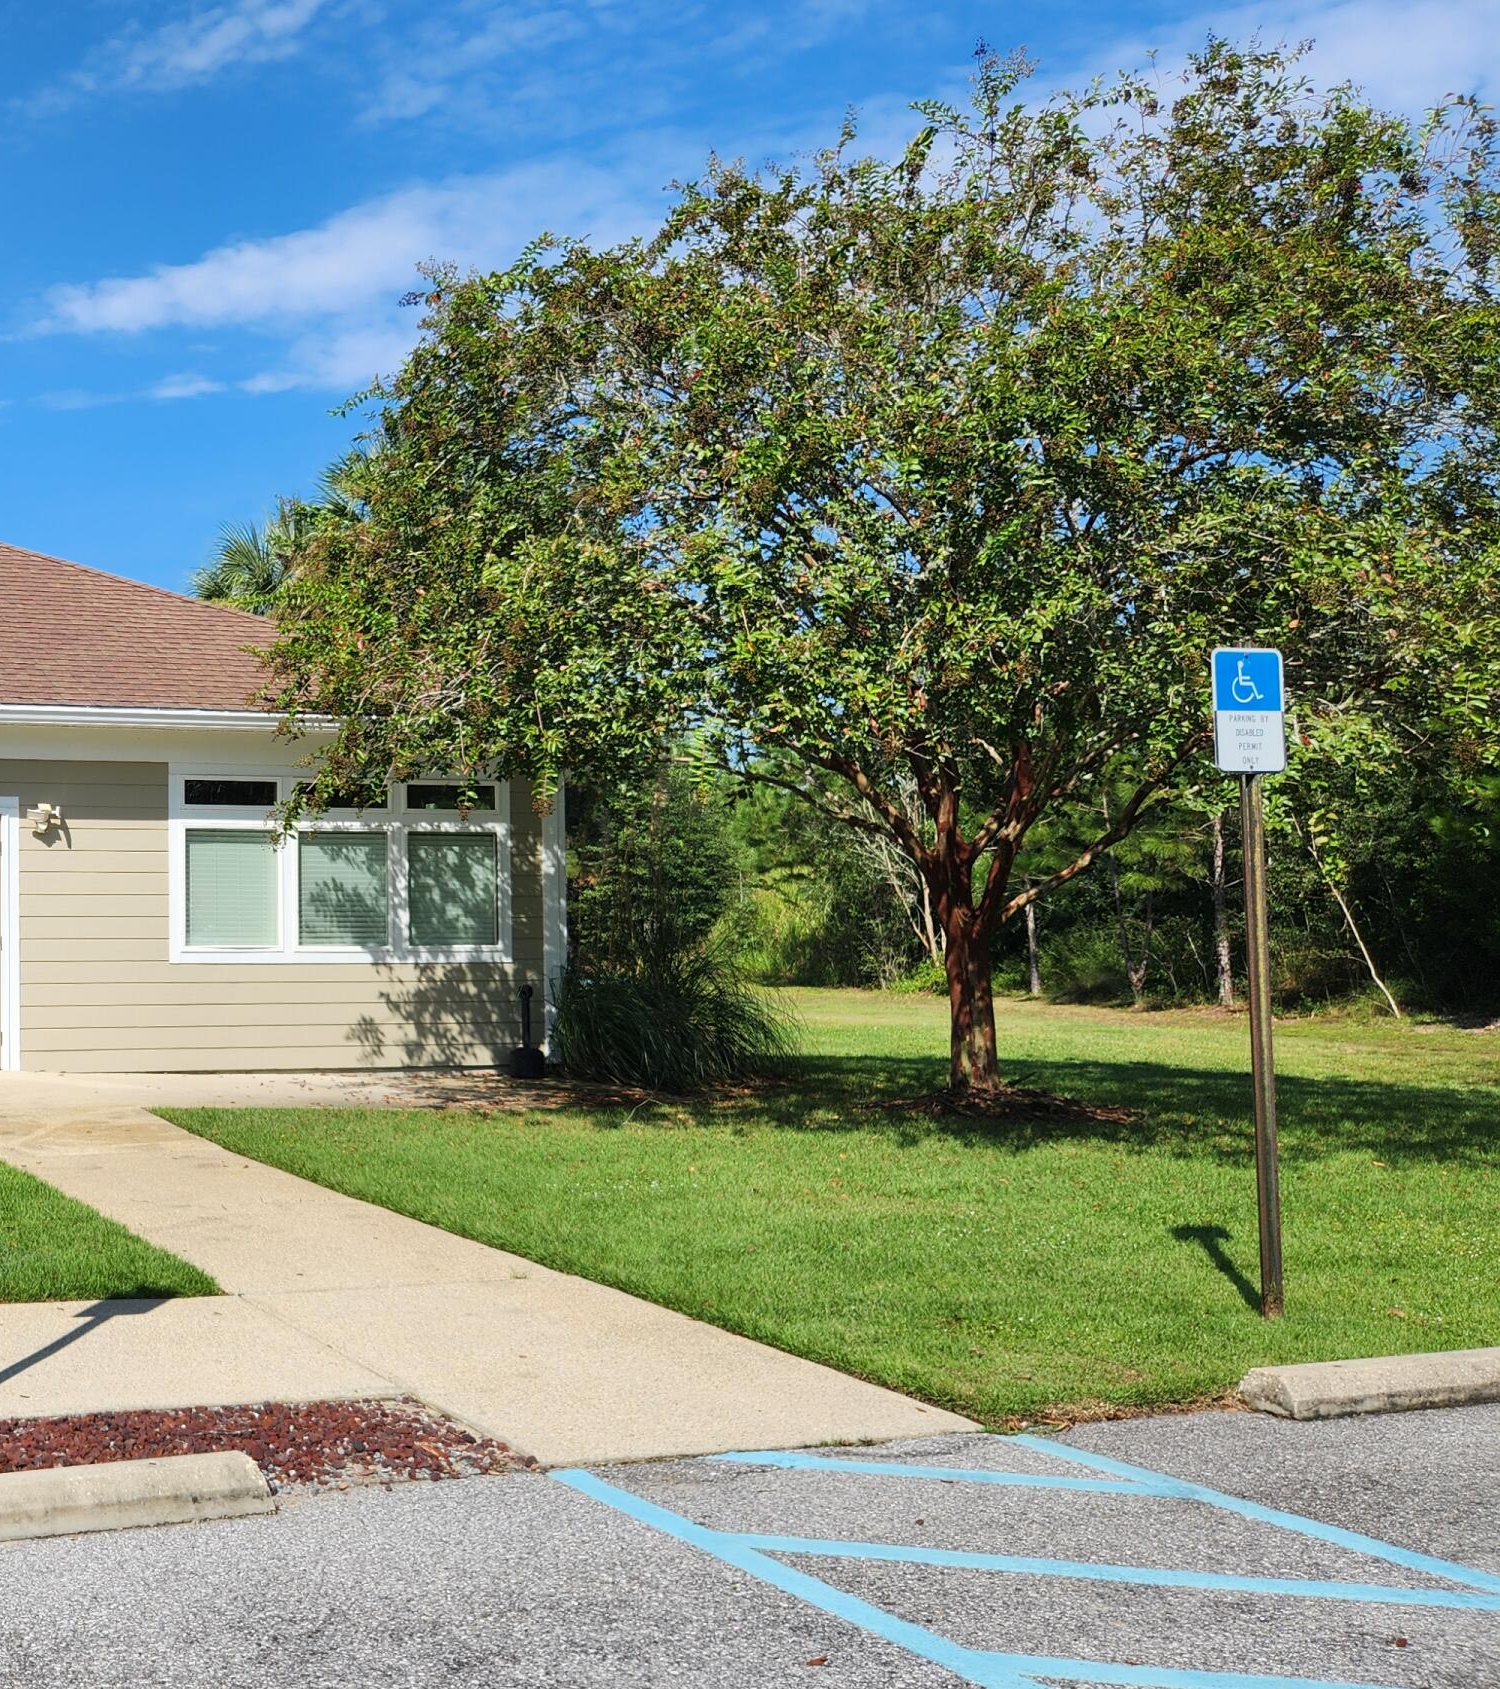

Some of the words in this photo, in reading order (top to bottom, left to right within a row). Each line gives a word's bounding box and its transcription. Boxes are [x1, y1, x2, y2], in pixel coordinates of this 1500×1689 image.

[1229, 714, 1256, 723] PARKING
[1260, 715, 1269, 723] BY
[1235, 728, 1264, 737] DISABLED
[1238, 742, 1262, 751] PERMIT
[1242, 756, 1260, 765] ONLY
